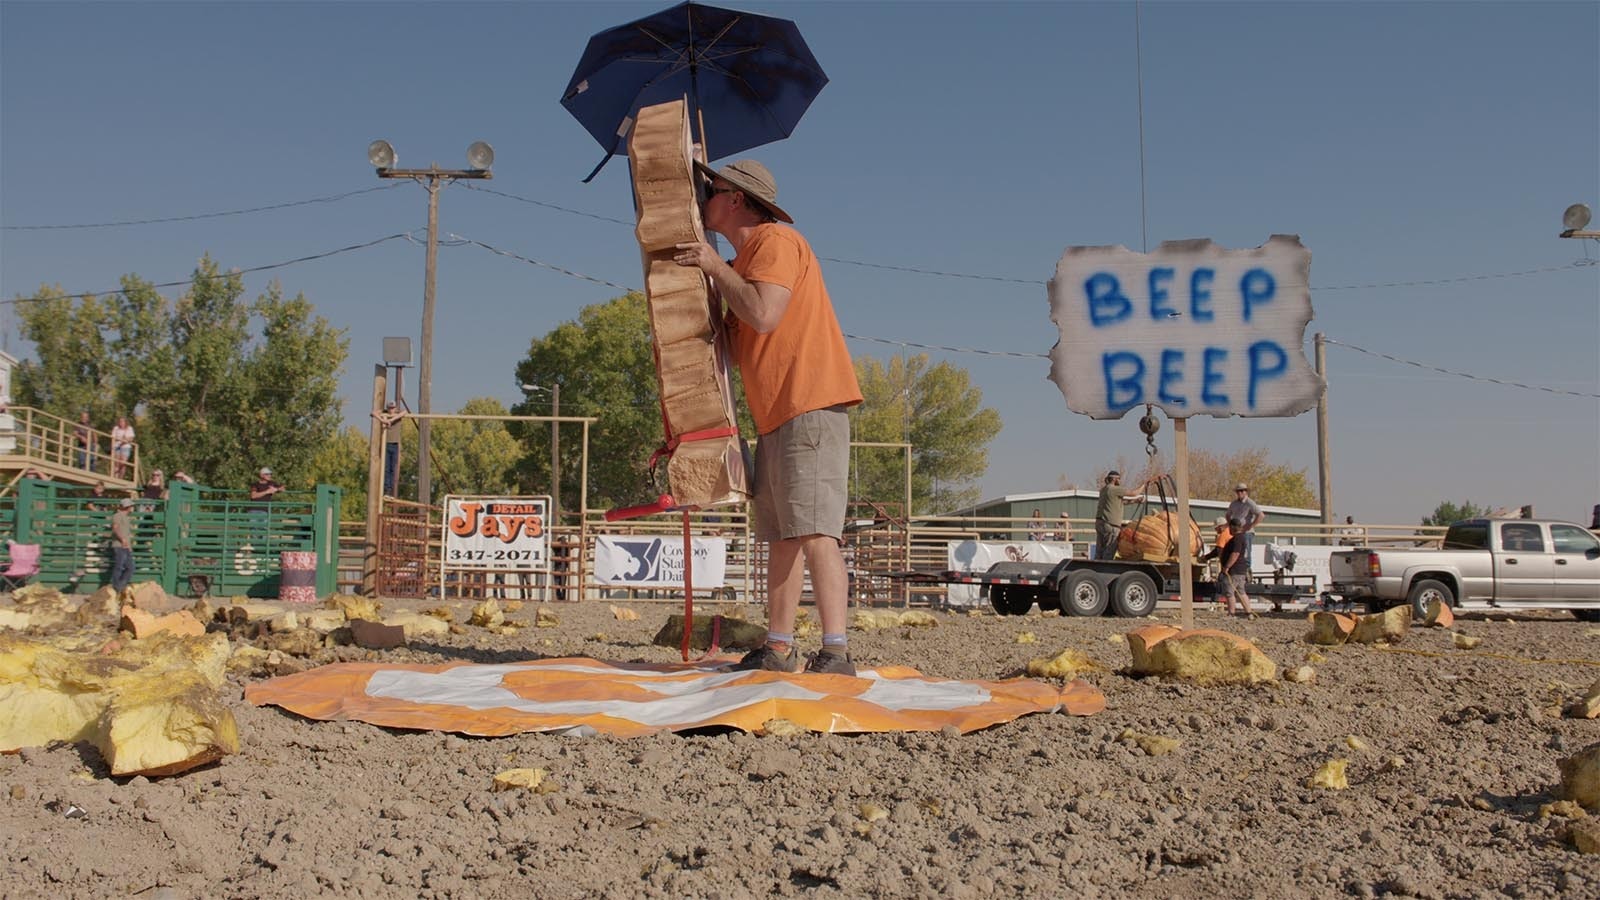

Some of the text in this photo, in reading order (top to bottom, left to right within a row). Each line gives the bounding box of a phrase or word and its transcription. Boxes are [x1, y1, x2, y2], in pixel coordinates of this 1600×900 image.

[1084, 267, 1277, 327] BEEP
[1103, 340, 1288, 411] BEEP
[492, 504, 537, 514] DETAIL
[450, 503, 544, 543] Jays
[450, 550, 540, 560] 347-2071
[662, 557, 685, 569] Stat
[662, 570, 685, 581] Dail
